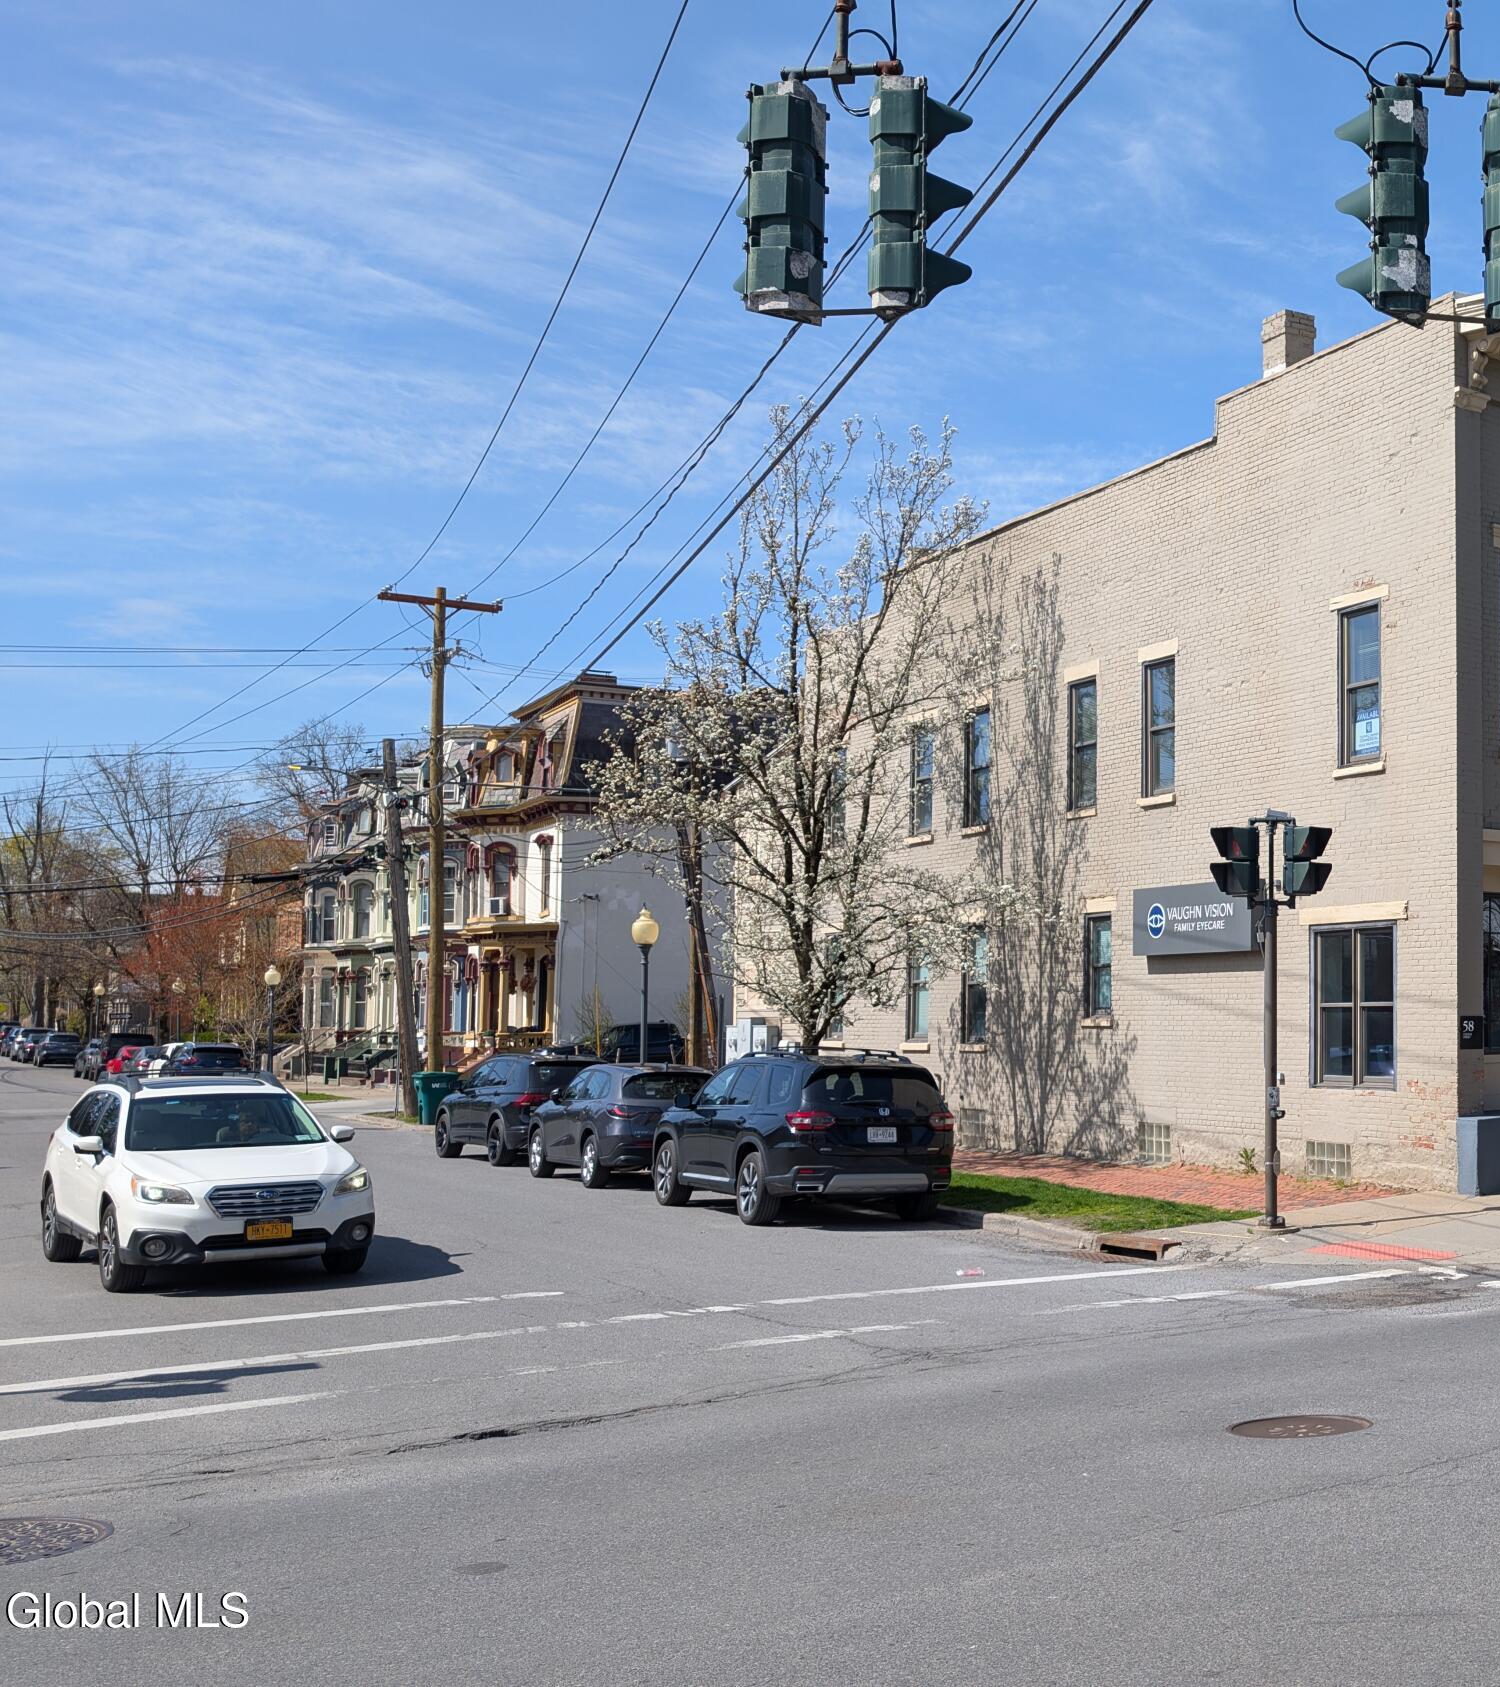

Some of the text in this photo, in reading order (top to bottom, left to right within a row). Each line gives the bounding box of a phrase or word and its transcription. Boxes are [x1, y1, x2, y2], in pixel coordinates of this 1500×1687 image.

[1166, 902, 1234, 920] VAUGHN VISION
[1173, 920, 1225, 932] FAMILY EYECARE
[1463, 1020, 1474, 1032] 58
